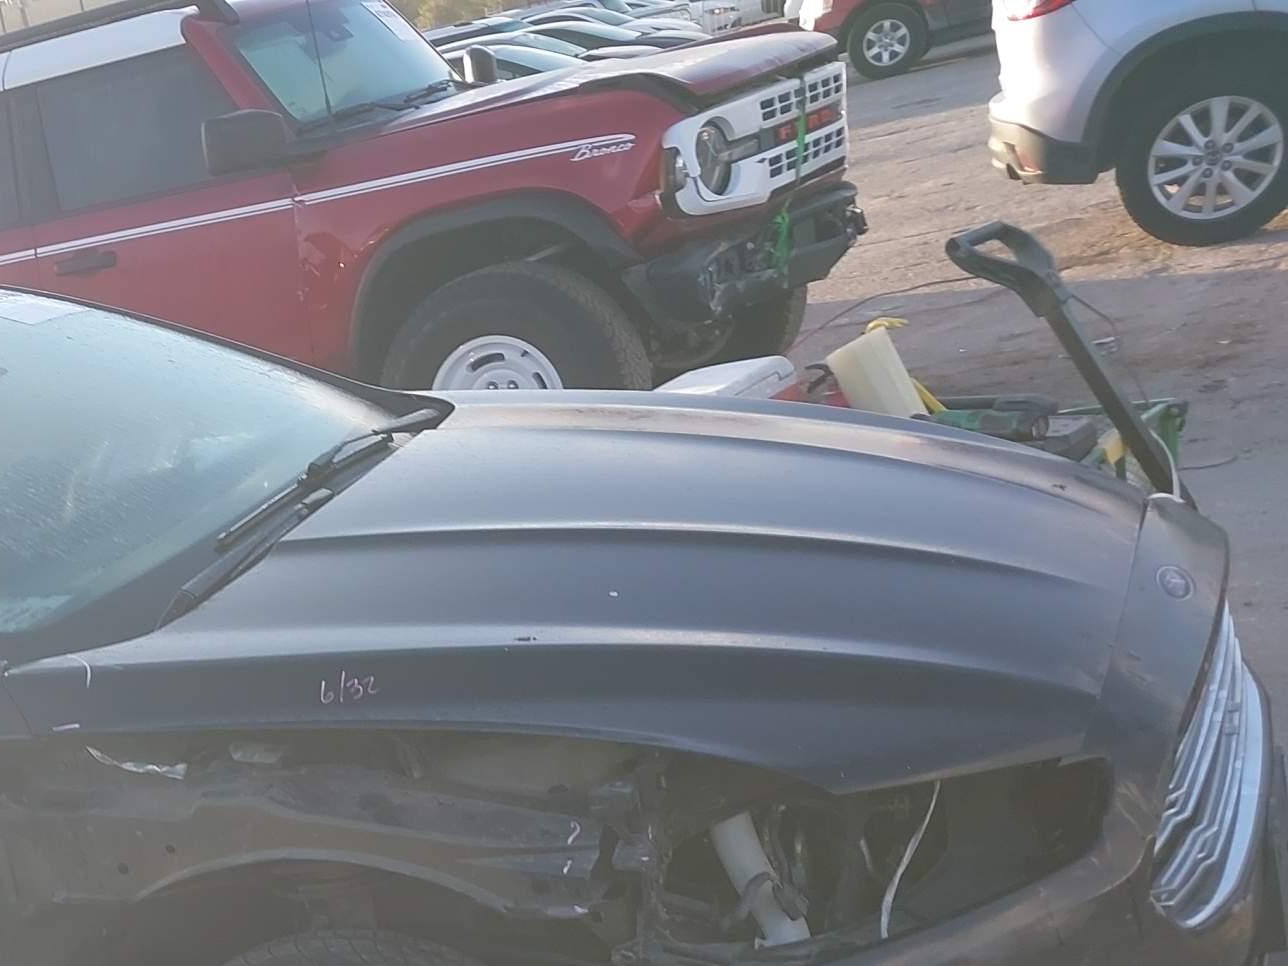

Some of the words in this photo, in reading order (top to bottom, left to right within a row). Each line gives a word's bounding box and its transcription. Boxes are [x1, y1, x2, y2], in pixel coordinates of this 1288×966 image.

[777, 108, 834, 143] FRD
[569, 142, 636, 162] Bronco
[319, 669, 379, 705] 6/32
